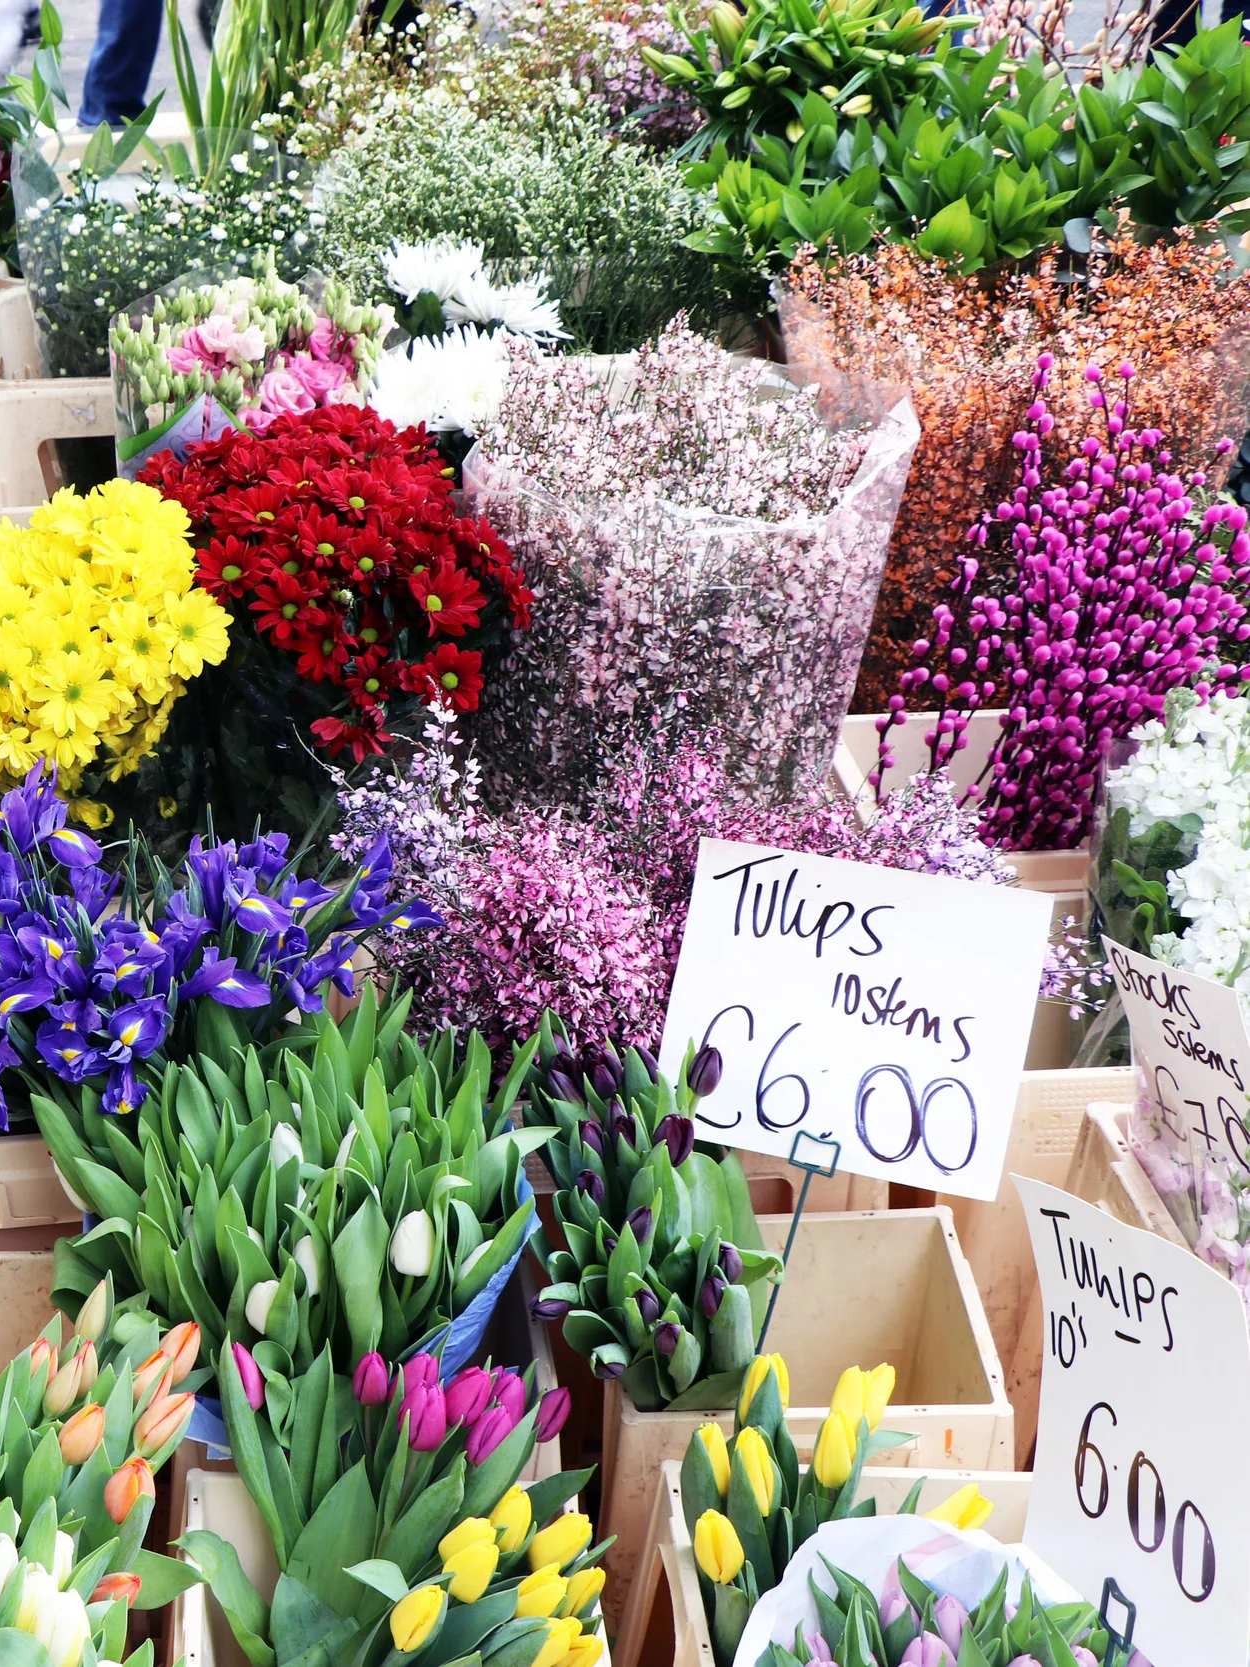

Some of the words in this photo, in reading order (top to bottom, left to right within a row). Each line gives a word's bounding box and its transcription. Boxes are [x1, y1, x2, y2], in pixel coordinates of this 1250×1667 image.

[712, 854, 896, 958] Tulips
[1110, 946, 1201, 1031] Stocks
[1039, 1207, 1179, 1352] Tulips
[1050, 1301, 1087, 1369] 10's
[1074, 1401, 1216, 1604] 6.00
